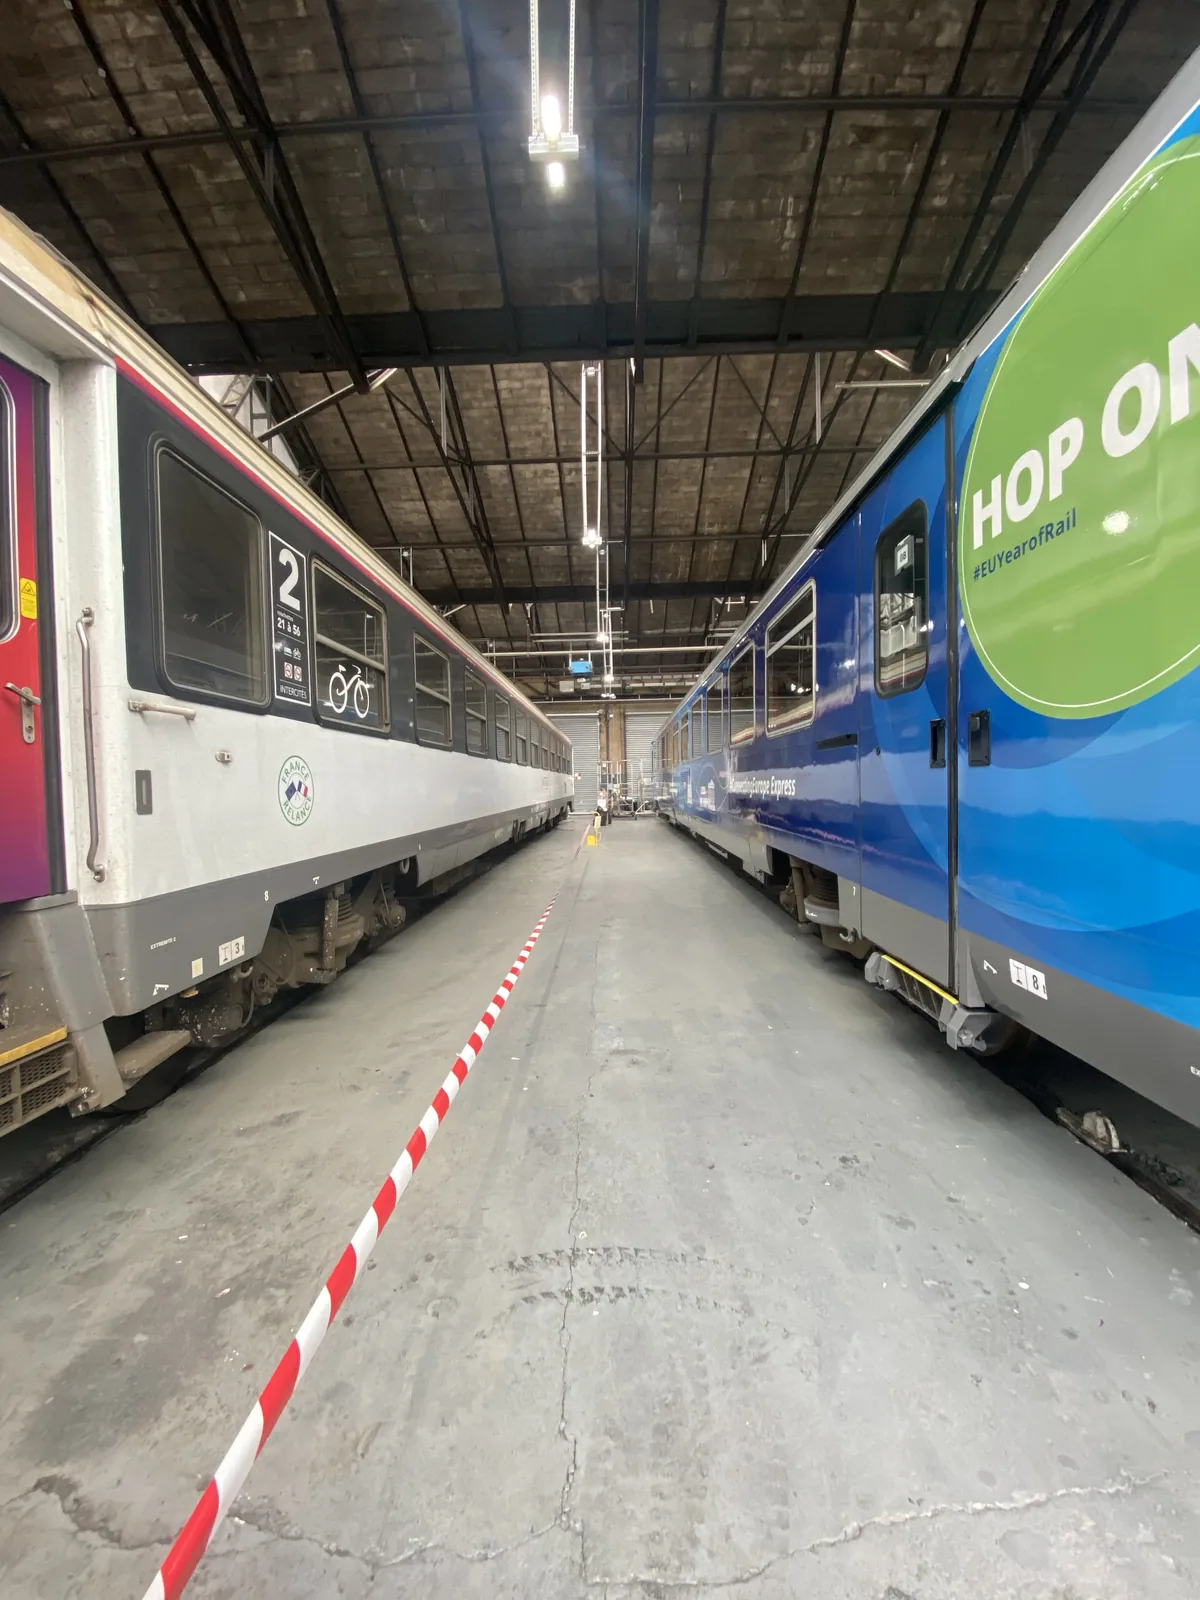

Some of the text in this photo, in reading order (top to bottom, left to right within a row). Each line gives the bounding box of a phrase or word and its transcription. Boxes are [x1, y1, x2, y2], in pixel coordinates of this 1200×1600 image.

[972, 416, 1085, 550] HOP
[972, 507, 1077, 582] #EUYearofRail
[278, 548, 301, 612] 2
[277, 617, 286, 630] 21
[293, 624, 301, 637] 56
[281, 760, 310, 784] FRANCE
[770, 776, 796, 801] Express
[283, 796, 312, 822] RELANCE
[264, 890, 269, 901] 8
